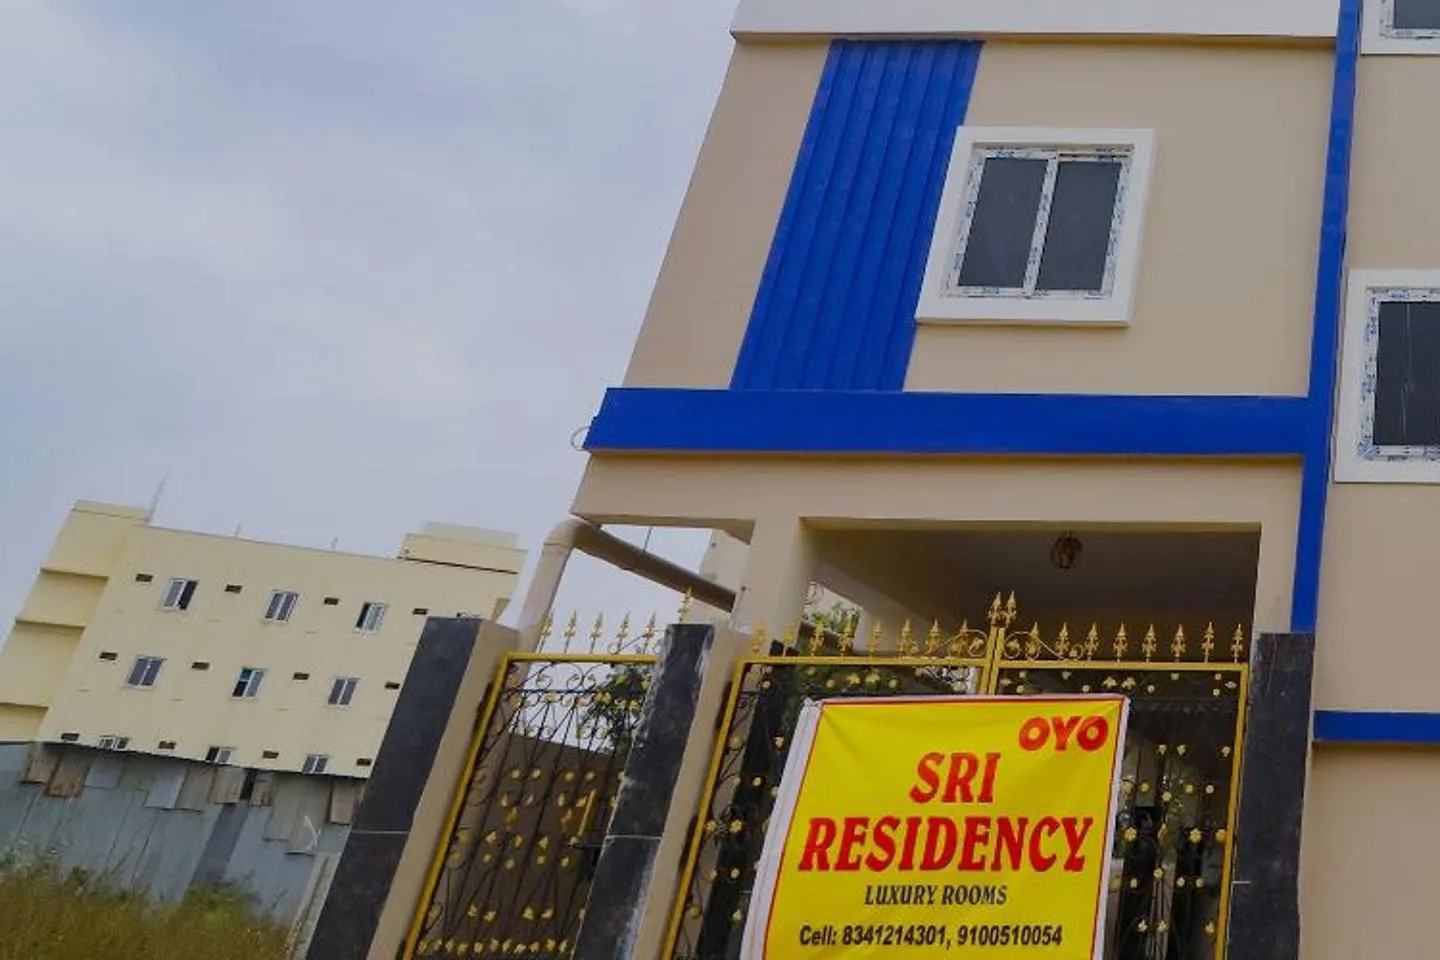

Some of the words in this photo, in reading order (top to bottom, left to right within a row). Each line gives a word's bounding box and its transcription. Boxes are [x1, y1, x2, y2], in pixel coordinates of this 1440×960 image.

[1018, 716, 1109, 752] OYO
[909, 752, 1002, 804] SRI
[798, 816, 1093, 872] RESIDENCY
[864, 885, 936, 906] LUXURY
[942, 885, 1007, 905] ROOMS
[799, 924, 837, 946] Cell:
[842, 925, 951, 950] 8341214301,
[957, 925, 1062, 946] 9100510054
